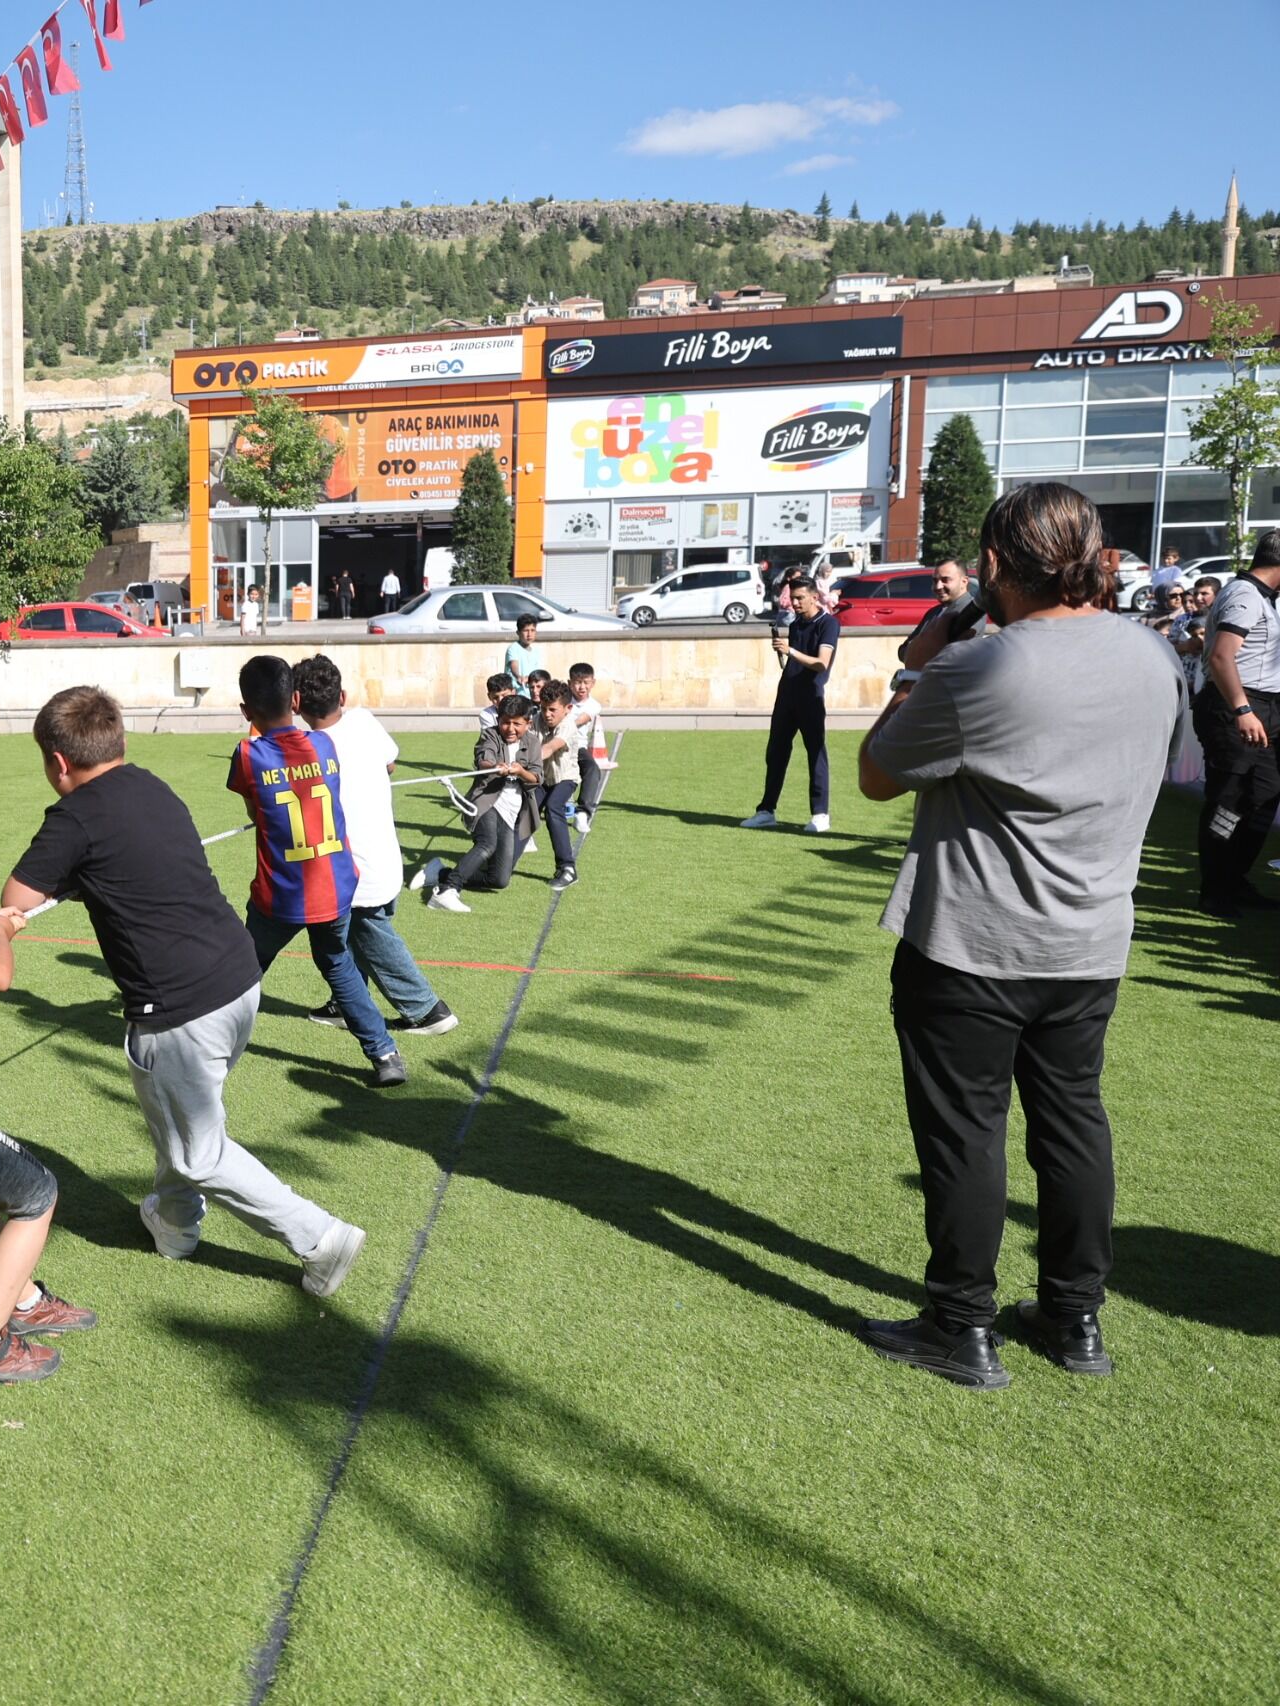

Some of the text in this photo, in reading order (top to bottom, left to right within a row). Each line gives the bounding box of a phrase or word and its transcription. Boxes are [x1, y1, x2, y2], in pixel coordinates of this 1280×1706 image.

[391, 338, 515, 356] LASSA BRIDGESTONE
[551, 348, 592, 366] Filli Boya
[663, 330, 773, 367] Filli Boya
[842, 346, 897, 358] YAĞMUR YAPI
[1034, 349, 1106, 368] AUTO
[193, 357, 329, 388] OTO PRATİK
[388, 413, 500, 436] ARAÇ BAKIMINDA
[385, 430, 501, 453] GÜVENİLİR SERVİS
[768, 420, 865, 454] Filli Boya
[377, 457, 459, 476] OTO PRATİK
[385, 475, 452, 487] CİVELEK AUTO
[261, 758, 339, 786] NEYMAR JR
[275, 783, 343, 862] 11
